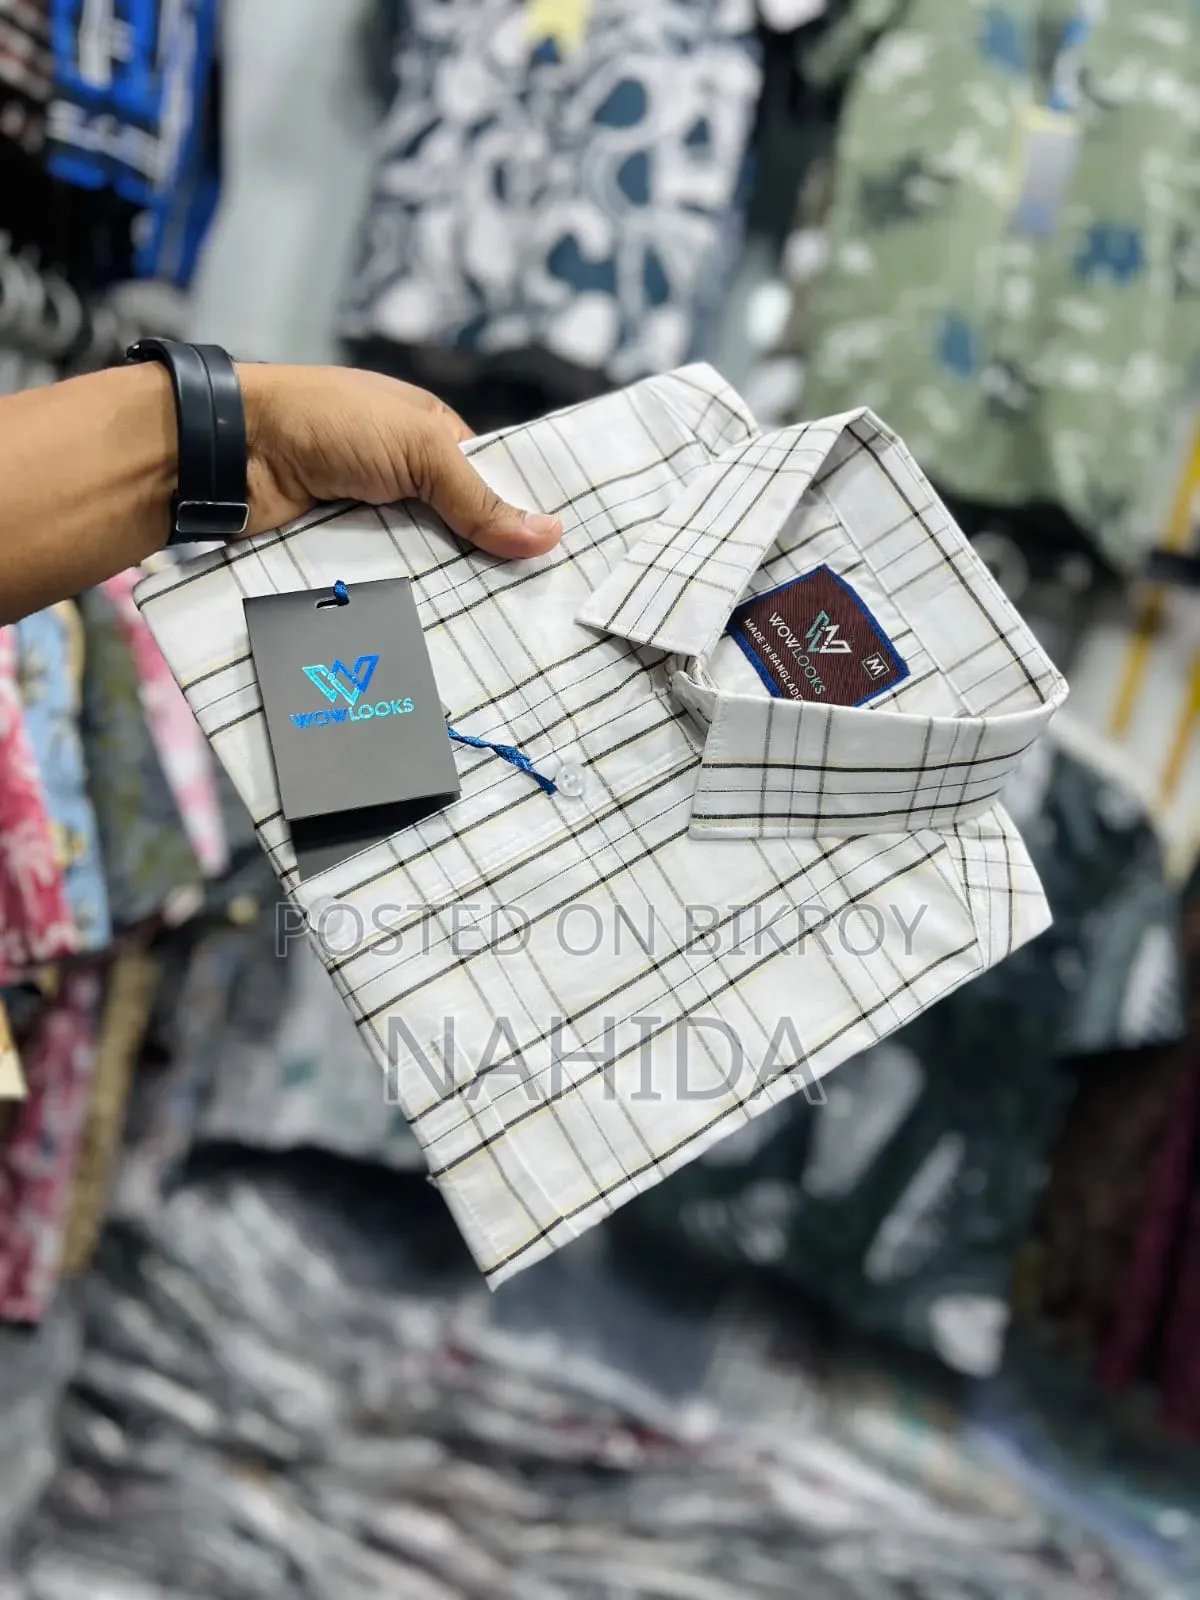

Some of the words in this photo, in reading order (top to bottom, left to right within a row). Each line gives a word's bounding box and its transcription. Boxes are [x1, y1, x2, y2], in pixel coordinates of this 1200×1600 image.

[744, 618, 766, 645] MADE
[762, 643, 773, 656] IN
[768, 611, 826, 695] WOWLOOKS
[866, 657, 885, 675] M
[289, 697, 415, 729] WOWLOOKS
